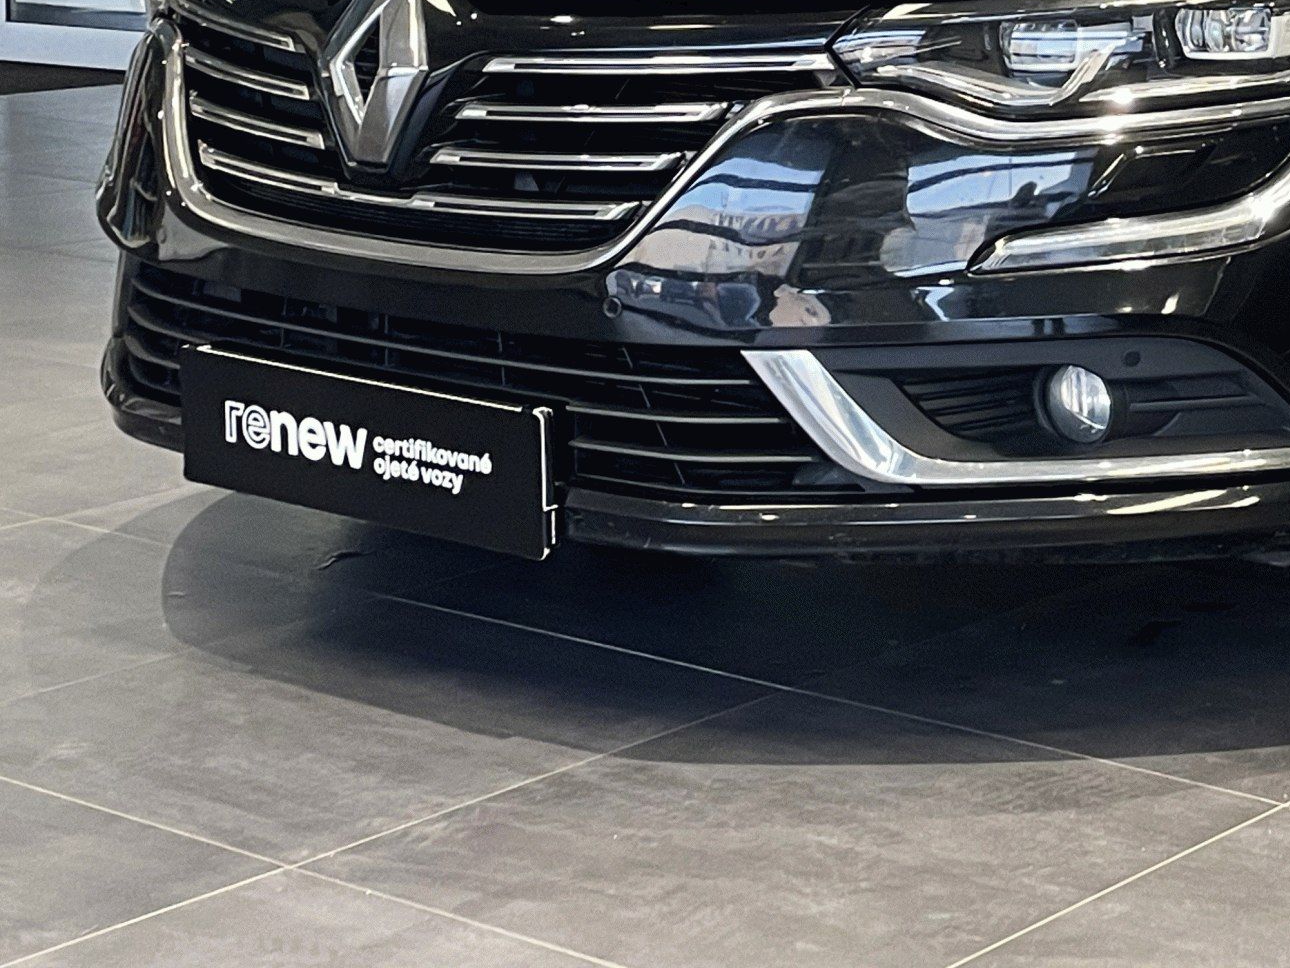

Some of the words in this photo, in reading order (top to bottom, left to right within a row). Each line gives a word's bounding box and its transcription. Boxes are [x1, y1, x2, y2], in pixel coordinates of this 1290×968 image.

[224, 400, 367, 469] renew
[373, 436, 492, 474] certifikované
[373, 454, 420, 482] ojeté
[420, 466, 464, 495] vozy
